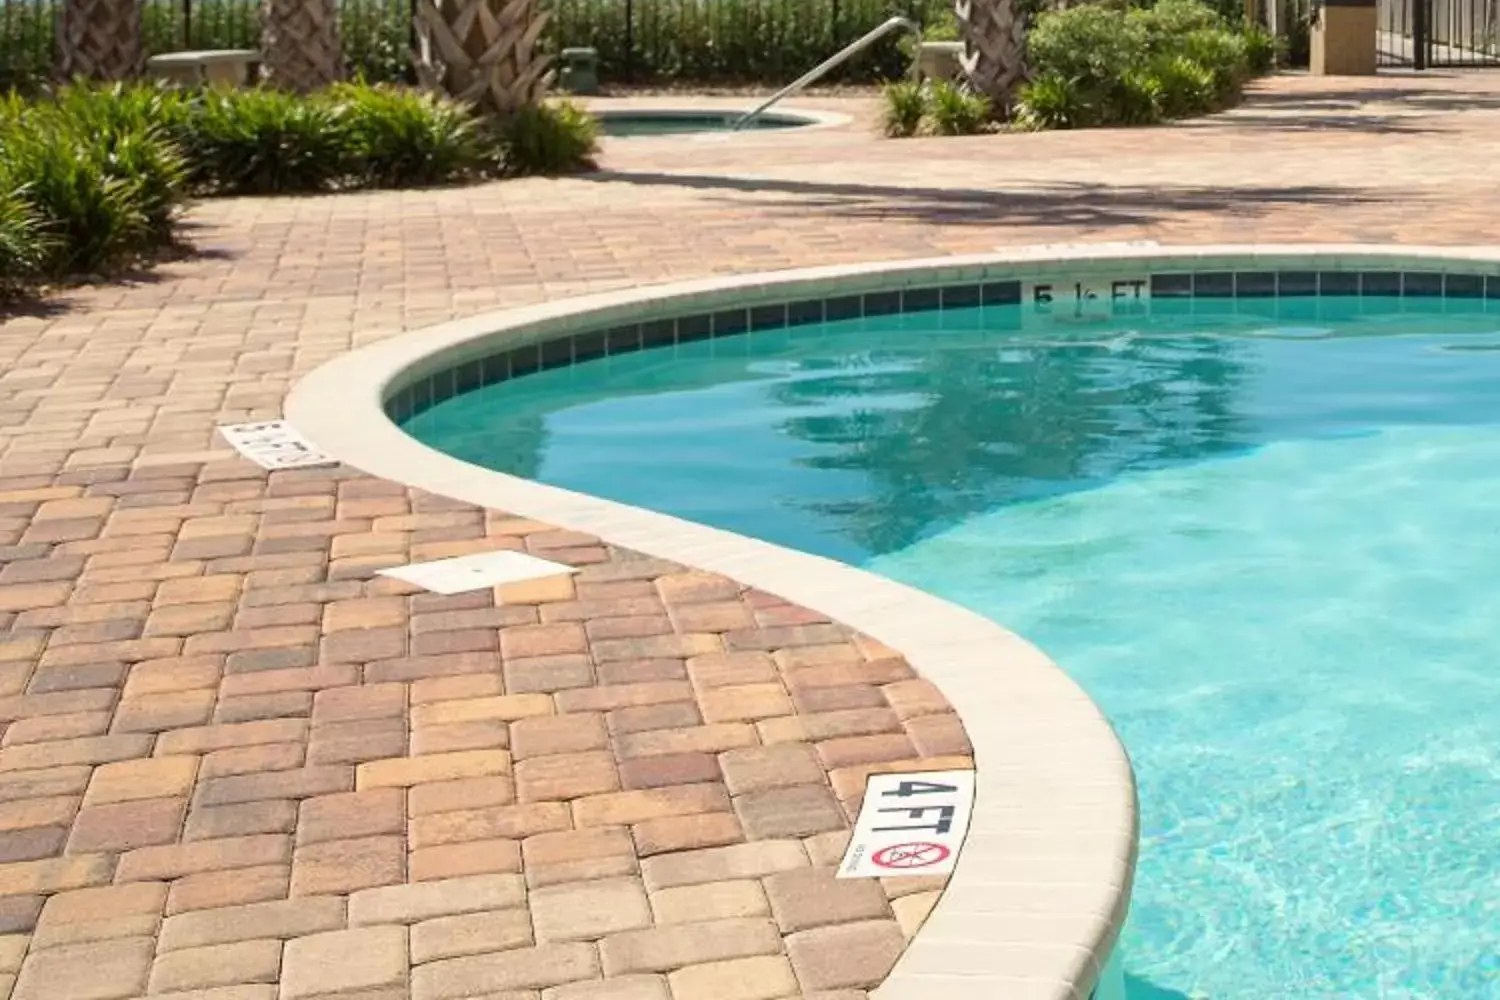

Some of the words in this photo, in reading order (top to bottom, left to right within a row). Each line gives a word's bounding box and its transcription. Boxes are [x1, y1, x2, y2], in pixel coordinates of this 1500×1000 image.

[1111, 280, 1147, 298] FT
[881, 780, 959, 798] 4
[871, 805, 955, 834] FT
